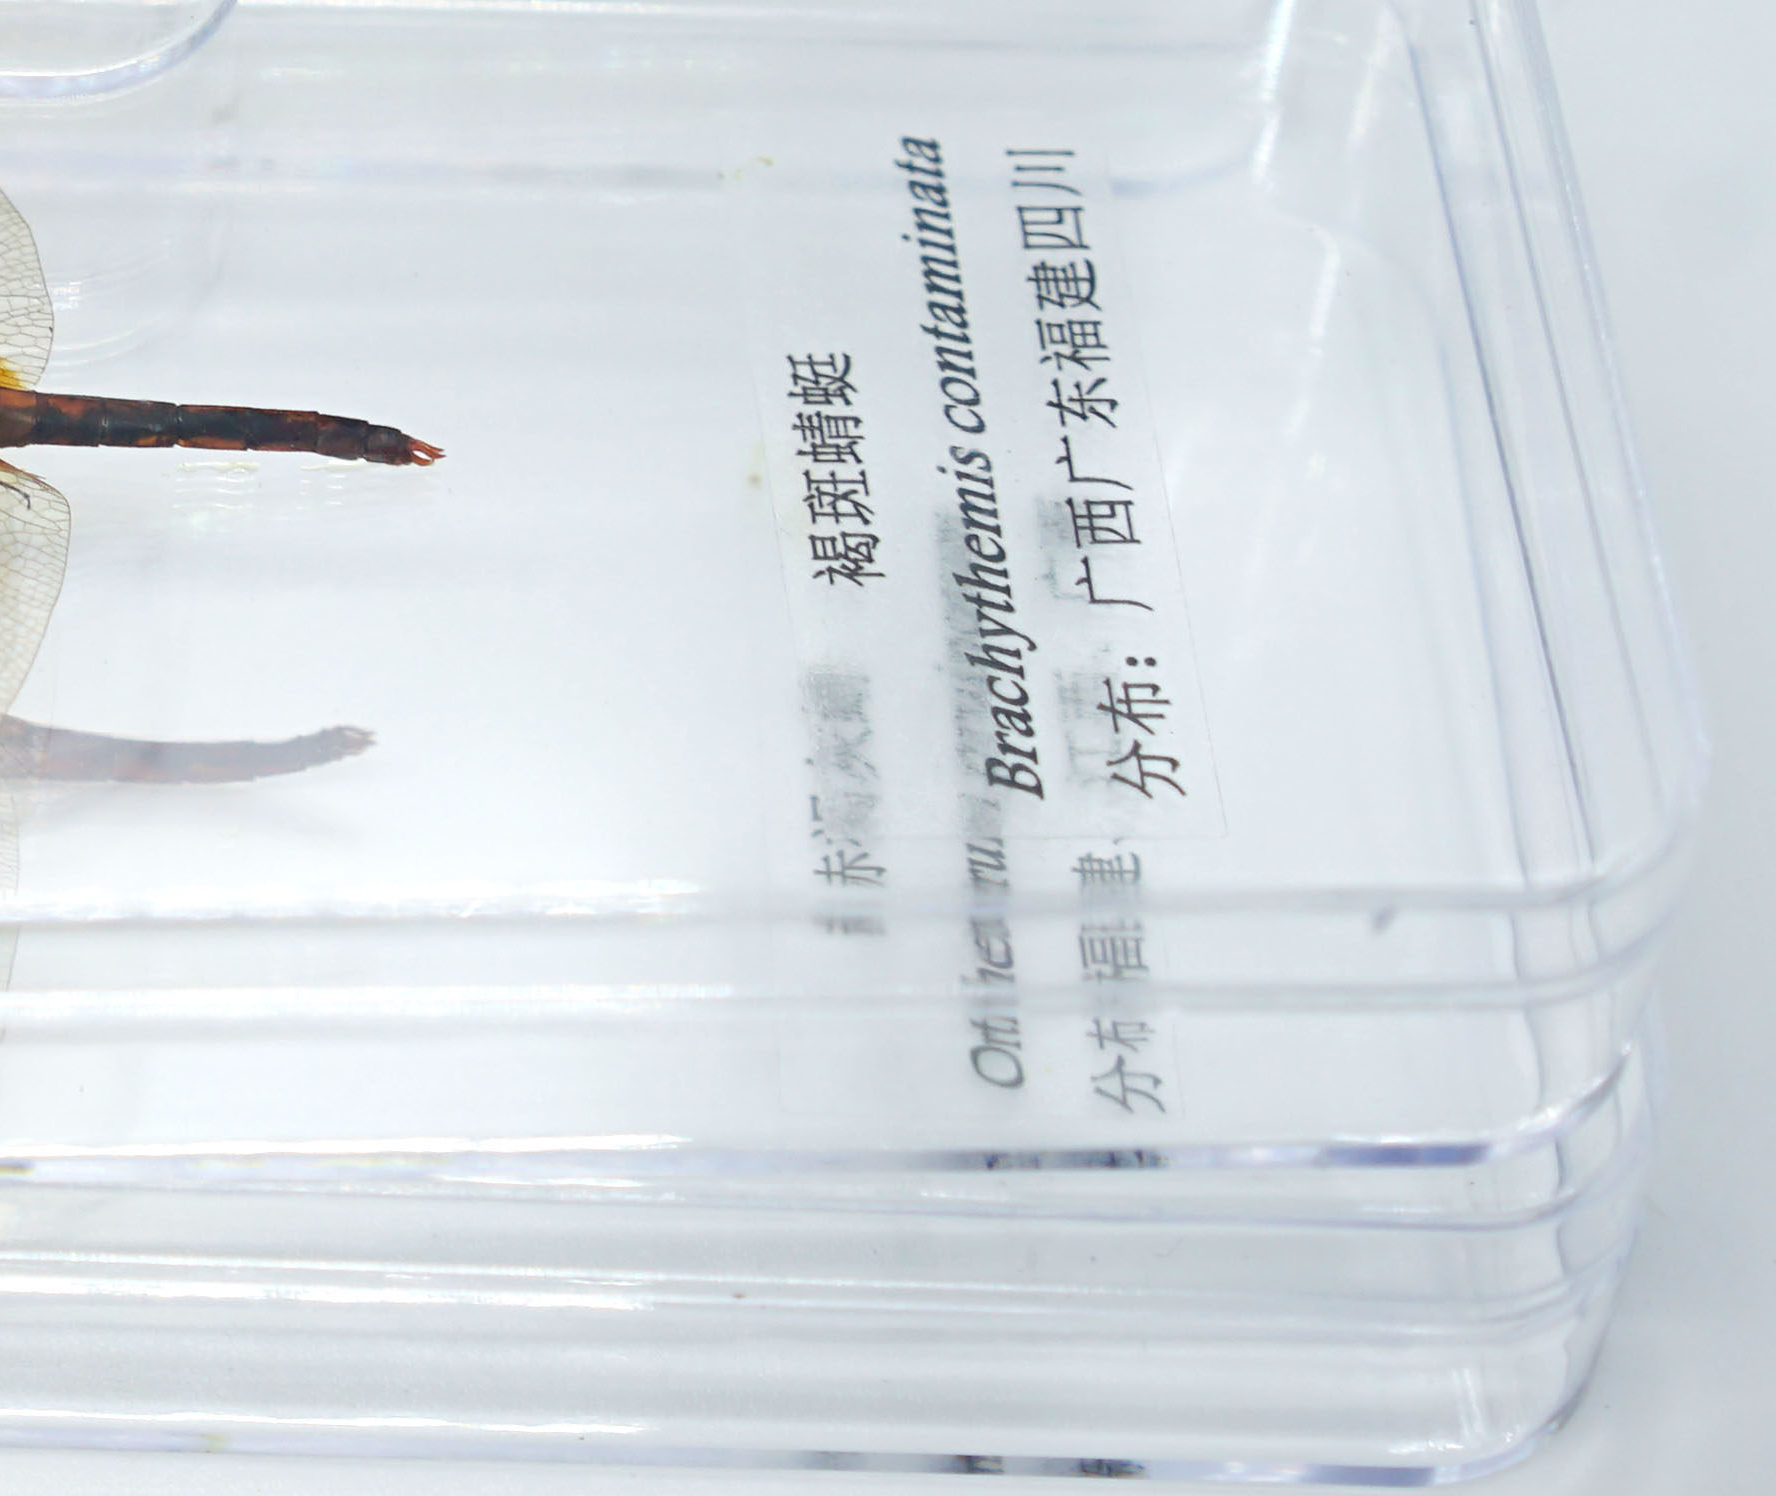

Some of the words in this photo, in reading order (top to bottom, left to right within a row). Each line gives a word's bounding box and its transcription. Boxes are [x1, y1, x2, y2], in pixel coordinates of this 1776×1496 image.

[894, 136, 986, 435] contaminata
[785, 352, 885, 586] 褐斑蜻蜓
[937, 447, 1045, 801] Brachythemis
